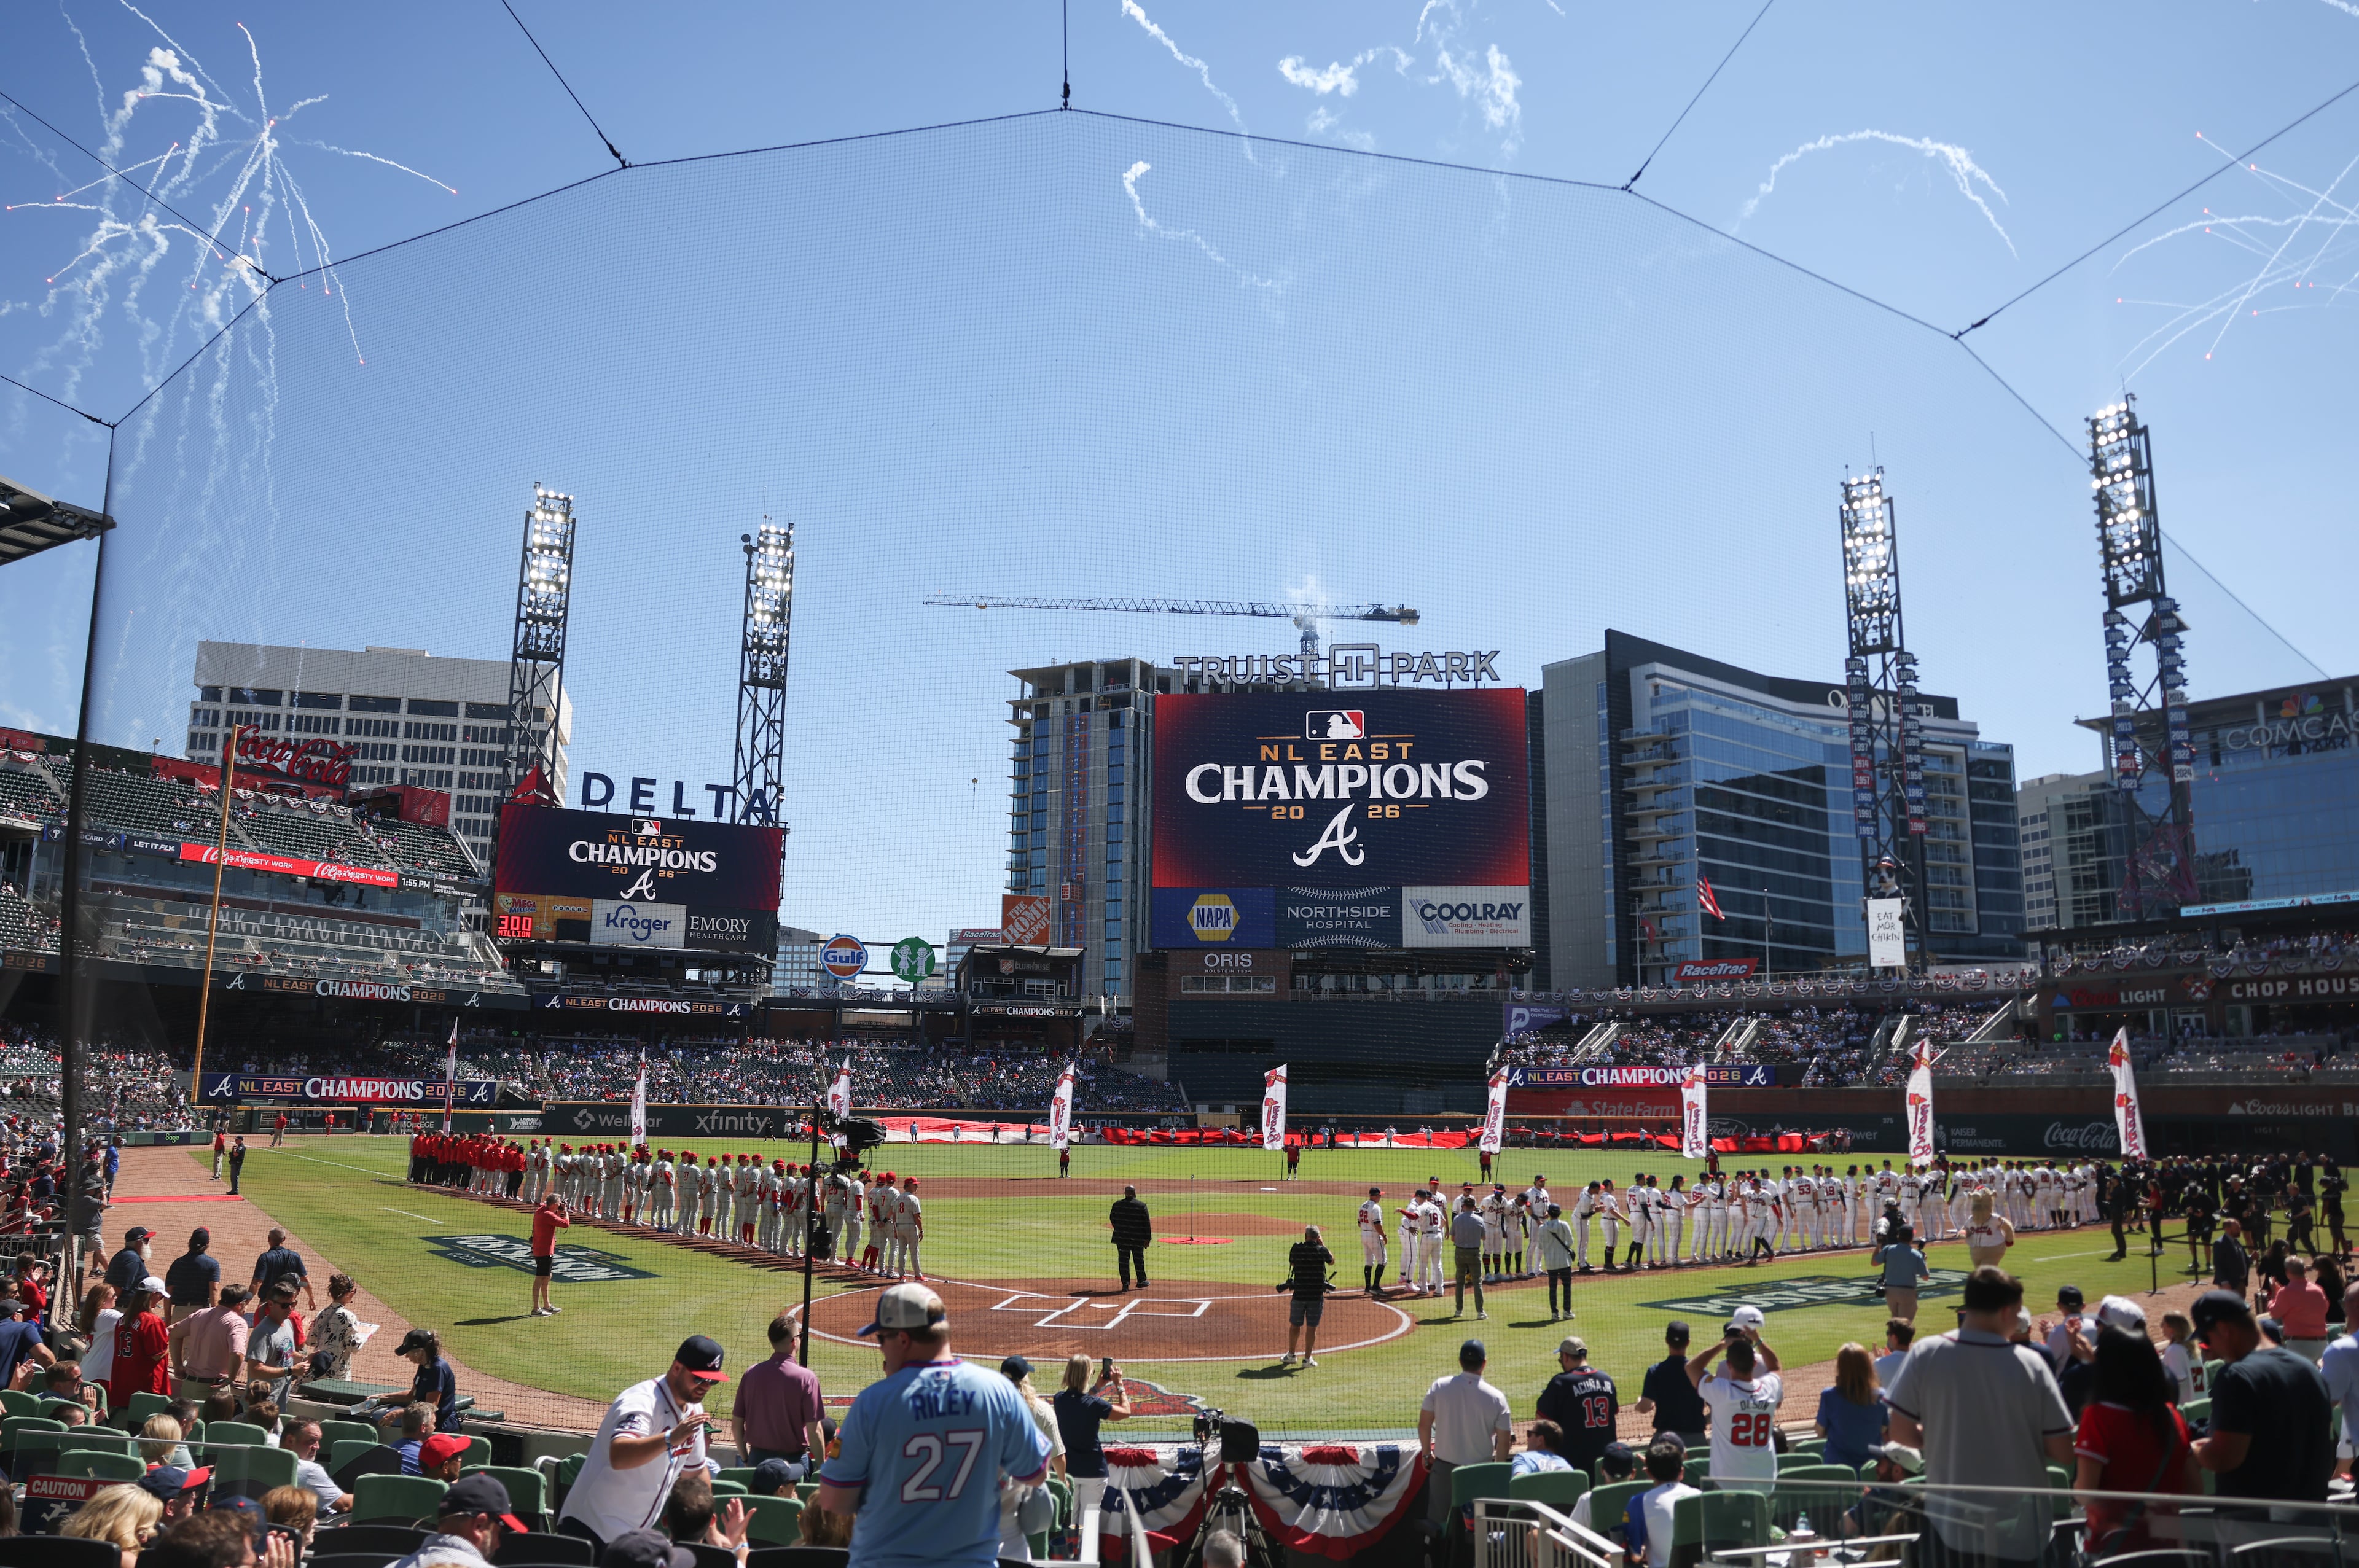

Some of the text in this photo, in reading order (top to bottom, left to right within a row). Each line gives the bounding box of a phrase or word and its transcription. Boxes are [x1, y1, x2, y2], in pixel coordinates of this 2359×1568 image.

[1174, 650, 1501, 686] TRUIST PARK
[1848, 660, 1862, 669] 1872
[1849, 676, 1864, 685] 1874
[1850, 693, 1864, 701] 1877
[2168, 693, 2184, 702] 2012
[1902, 704, 1917, 713] 1891
[2116, 722, 2132, 731] 2013
[2172, 730, 2188, 740] 2020
[1260, 742, 1414, 762] NL EAST
[1853, 743, 1868, 752] 1897
[2118, 741, 2134, 750] 2019
[224, 725, 362, 784] Coca-Cola
[1906, 754, 1921, 763] 1948
[2173, 749, 2189, 759] 2022
[1855, 759, 1869, 768] 1914
[2119, 759, 2135, 768] 2021
[1906, 771, 1922, 781] 1958
[2176, 768, 2192, 778] 2024
[1185, 760, 1490, 804] CHAMPIONS
[1855, 775, 1870, 785] 1957
[1908, 787, 1923, 797] 1982
[581, 771, 774, 827] DELTA
[1272, 805, 1401, 819] 20 26
[1858, 809, 1872, 818] 1991
[1909, 805, 1925, 814] 1992
[1859, 825, 1874, 835] 1993
[1910, 822, 1925, 831] 1995
[133, 840, 148, 849] LET
[607, 833, 684, 849] NL EAST
[569, 840, 718, 873] CHAMPIONS
[659, 870, 675, 878] 26
[402, 878, 430, 889] 1:55 PM
[512, 897, 536, 908] MEGA
[1007, 900, 1028, 919] THE
[1287, 905, 1391, 918] NORTHSIDE
[1420, 903, 1523, 921] COOLRAY
[606, 904, 671, 942] Kroger
[1002, 897, 1051, 944] HOME
[1196, 908, 1232, 928] NAPA
[1877, 912, 1893, 921] EAT
[498, 915, 533, 932] 300
[689, 916, 751, 933] EMORY
[1021, 915, 1051, 945] DEPOT
[1306, 921, 1372, 929] HOSPITAL
[1877, 921, 1895, 931] MOR
[689, 932, 747, 942] HEALTHCARE
[1872, 933, 1901, 942] CHIKIN
[4, 954, 46, 969] 2026
[823, 950, 864, 965] Gulf
[1204, 953, 1253, 967] ORIS
[1680, 964, 1748, 977] RaceTrac
[264, 978, 445, 1002] NL EAST CHAMPIONS 2026
[2231, 981, 2289, 999] CHOP
[2070, 988, 2166, 1007] Coors LIGHT
[581, 999, 608, 1007] EAST
[608, 997, 691, 1013] CHAMPIONS
[692, 1004, 722, 1013] 2026
[1006, 1007, 1055, 1016] CHAMPIONS
[1528, 1067, 1692, 1086] NL EAST CHAMPIONS
[238, 1080, 259, 1092] NL
[262, 1081, 303, 1093] EAST
[305, 1077, 424, 1100] CHAMPIONS
[2245, 1099, 2334, 1115] Coors LIGHT
[598, 1114, 663, 1128] Wellar
[695, 1110, 769, 1135] xfinity
[1160, 1116, 1186, 1127] PAPA
[165, 1133, 179, 1144] Sage
[2044, 1121, 2118, 1149] Coca-Cola
[1951, 1139, 2003, 1148] PERMANENTE
[1798, 1184, 1812, 1195] 53
[882, 1195, 886, 1206] 7
[1629, 1194, 1637, 1206] 75
[899, 1201, 904, 1214] 8
[1359, 1210, 1369, 1224] 22
[1429, 1213, 1439, 1226] 18
[1573, 1378, 1602, 1397] ACUÑA
[910, 1390, 976, 1422] RILEY
[1582, 1396, 1609, 1428] 13
[1740, 1400, 1770, 1411] OLSON
[1731, 1413, 1770, 1447] 28
[901, 1428, 985, 1503] 27
[32, 1480, 86, 1497] CAUTION
